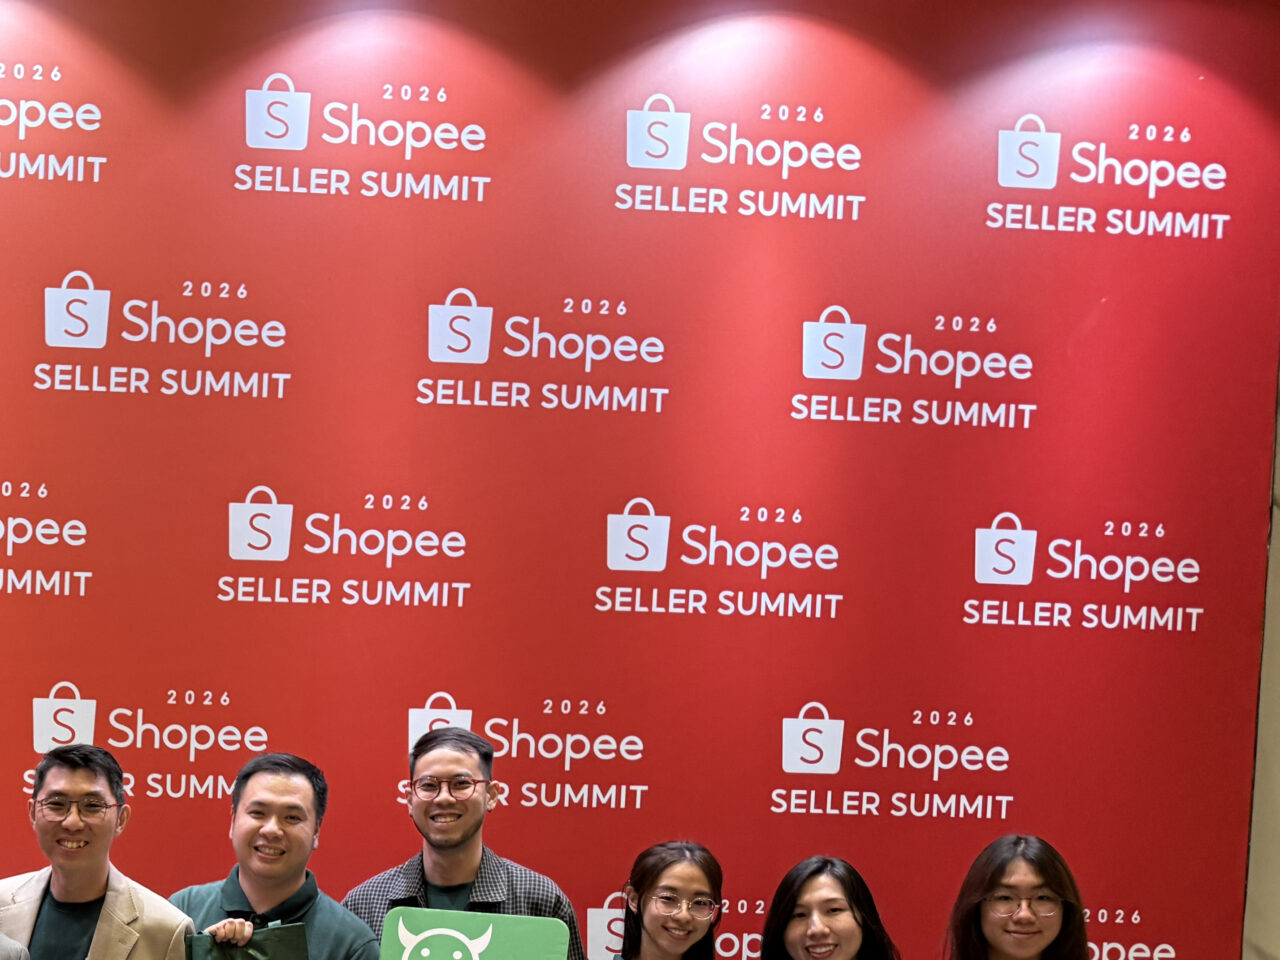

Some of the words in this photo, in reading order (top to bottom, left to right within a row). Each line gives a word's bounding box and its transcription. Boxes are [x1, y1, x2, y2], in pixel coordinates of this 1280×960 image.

[382, 83, 447, 103] 2026
[760, 103, 824, 123] 2026
[321, 102, 487, 161] Shopee
[1128, 123, 1192, 143] 2026
[700, 122, 862, 180] Shopee
[233, 164, 351, 196] SELLER
[359, 170, 492, 203] SUMMIT
[1069, 141, 1228, 199] Shopee
[614, 183, 729, 215] SELLER
[737, 189, 867, 221] SUMMIT
[985, 202, 1097, 233] SELLER
[1104, 208, 1232, 240] SUMMIT
[182, 280, 248, 299] 2026
[563, 297, 627, 316] 2026
[120, 298, 287, 358] Shopee
[934, 314, 998, 333] 2026
[502, 315, 665, 373] Shopee
[875, 332, 1034, 390] Shopee
[32, 362, 150, 394] SELLER
[159, 368, 292, 399] SUMMIT
[415, 378, 531, 408] SELLER
[540, 382, 670, 414] SUMMIT
[790, 393, 903, 424] SELLER
[911, 399, 1038, 429] SUMMIT
[363, 493, 429, 511] 2026
[739, 506, 803, 524] 2026
[303, 512, 467, 569] Shopee
[1103, 520, 1166, 538] 2026
[680, 524, 839, 580] Shopee
[1045, 538, 1201, 594] Shopee
[216, 575, 332, 605] SELLER
[341, 578, 472, 608] SUMMIT
[594, 585, 708, 615] SELLER
[716, 589, 844, 619] SUMMIT
[962, 598, 1073, 628] SELLER
[1081, 603, 1205, 632] SUMMIT
[166, 690, 231, 706] 2026
[542, 699, 607, 715] 2026
[107, 707, 268, 762] Shopee
[912, 709, 974, 727] 2026
[484, 717, 644, 771] Shopee
[853, 727, 1010, 782] Shopee
[146, 773, 238, 799] SUMM
[520, 782, 649, 809] SUMMIT
[769, 788, 881, 816] SELLER
[889, 791, 1015, 820] SUMMIT
[721, 899, 765, 914] 202
